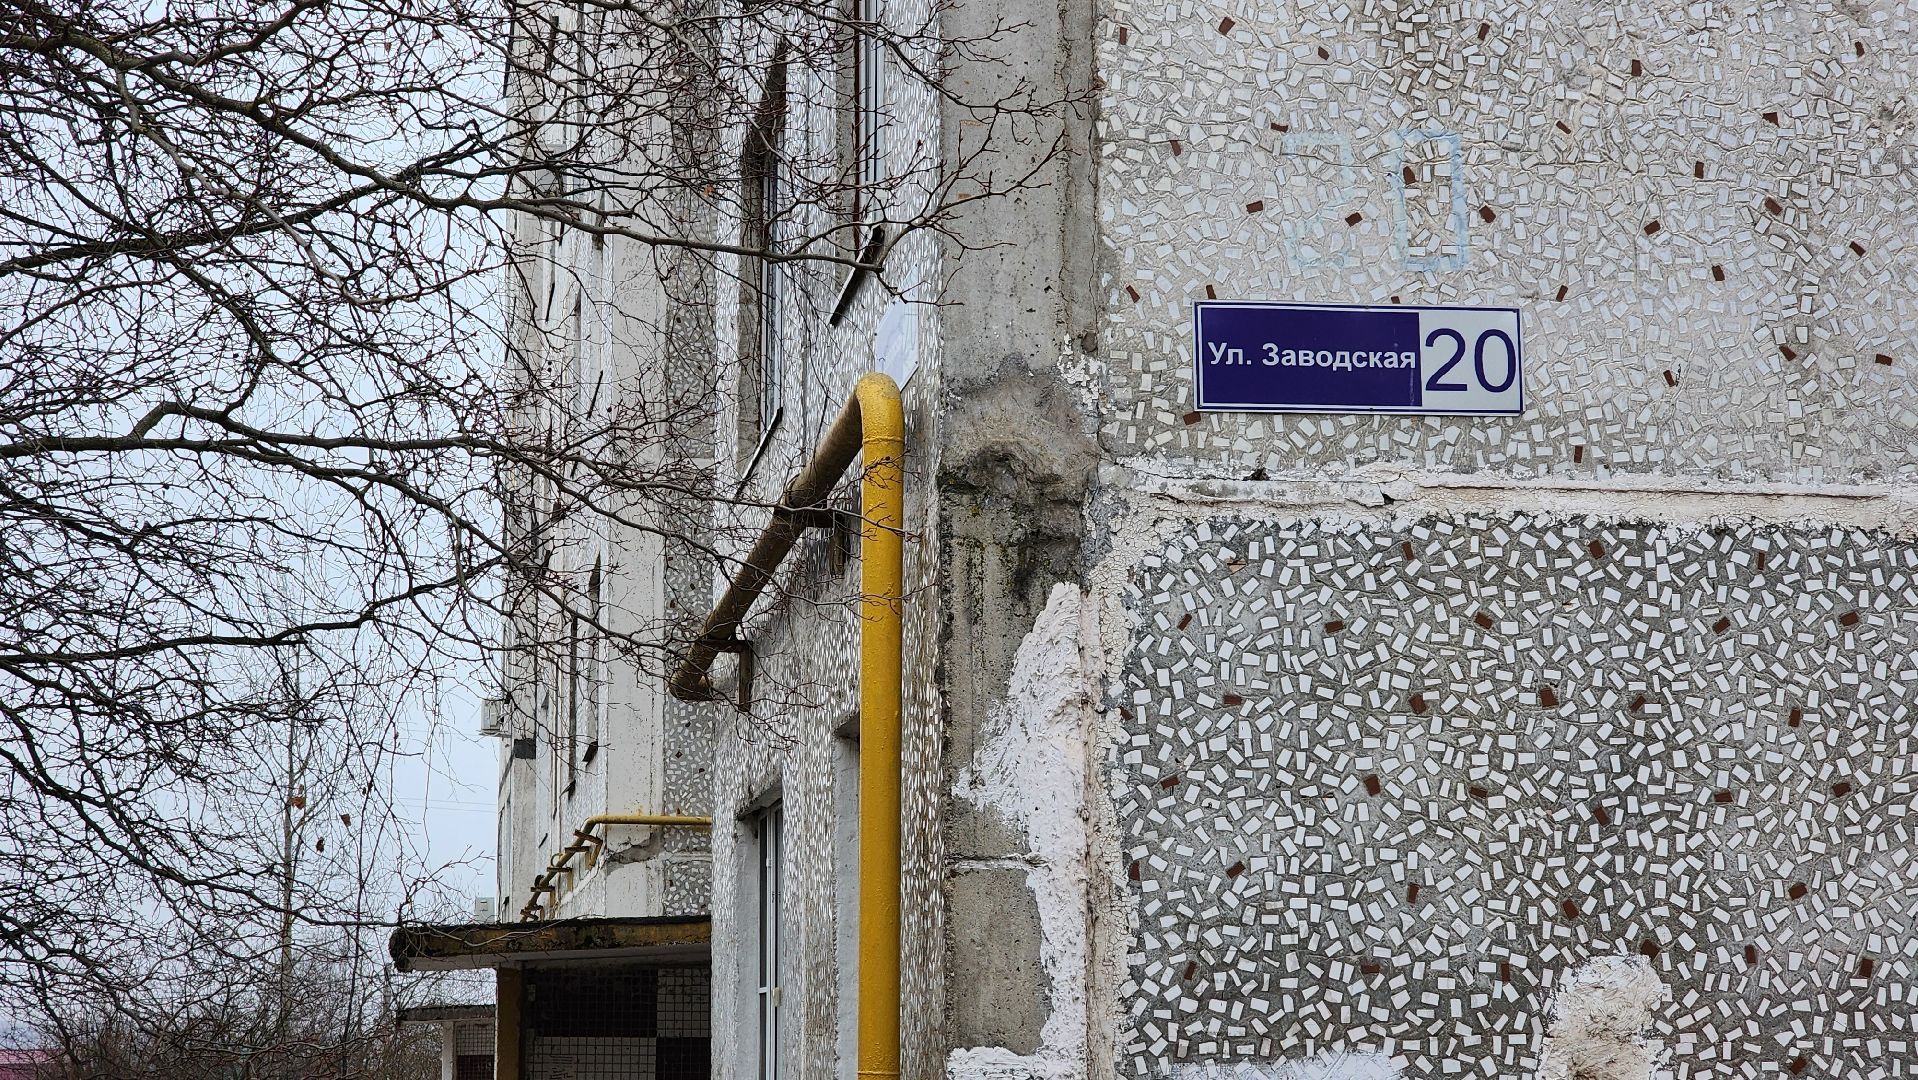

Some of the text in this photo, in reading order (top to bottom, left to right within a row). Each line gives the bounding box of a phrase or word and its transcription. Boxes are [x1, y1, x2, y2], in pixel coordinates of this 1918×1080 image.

[1208, 328, 1516, 393] Ул. Заводская 20
